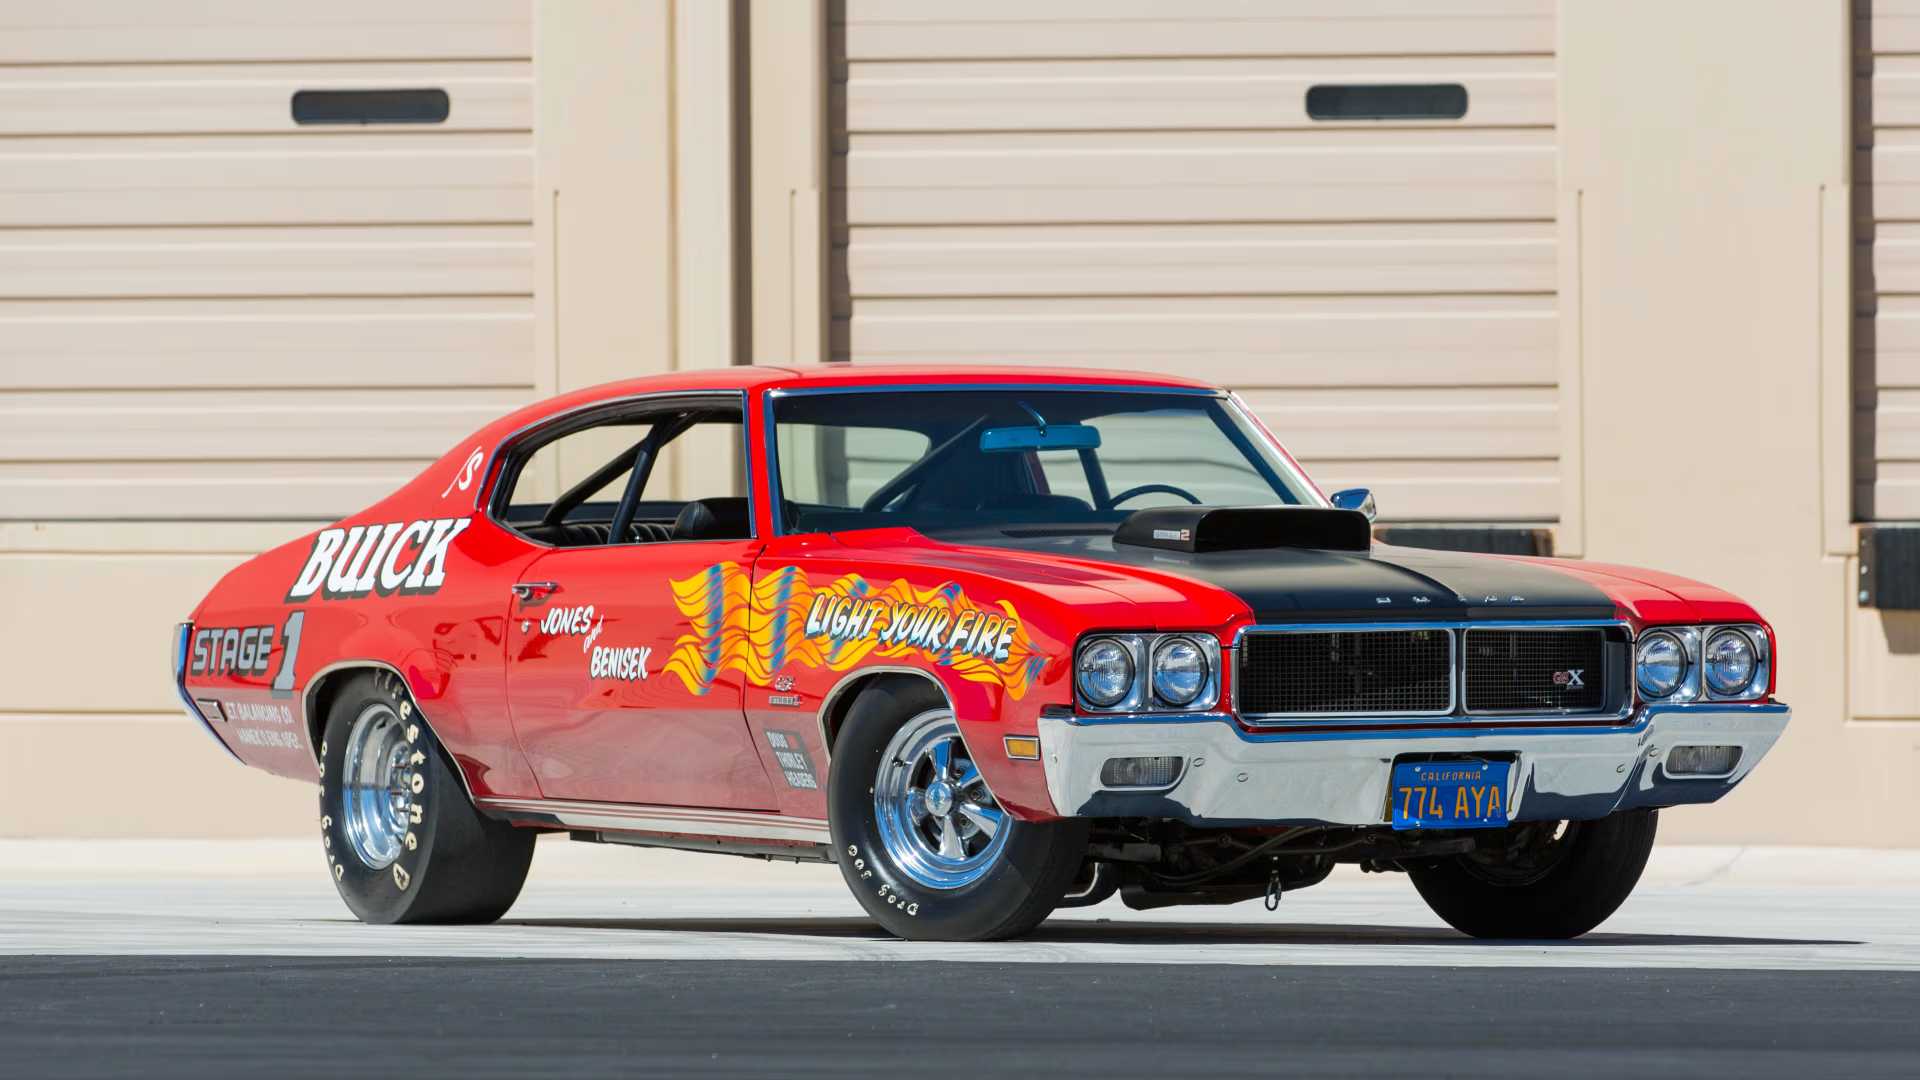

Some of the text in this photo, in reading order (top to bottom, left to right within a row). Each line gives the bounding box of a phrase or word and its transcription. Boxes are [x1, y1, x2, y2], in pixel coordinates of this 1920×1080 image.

[285, 517, 473, 603] BUICK
[540, 605, 595, 635] JONES
[583, 614, 603, 653] and
[804, 592, 1017, 662] LIGHT YOUR FIRE
[191, 611, 305, 698] STAGE 1
[590, 646, 652, 680] BENISEK
[1420, 771, 1481, 782] CALIFORNIA
[1399, 786, 1502, 820] 774 AYA
